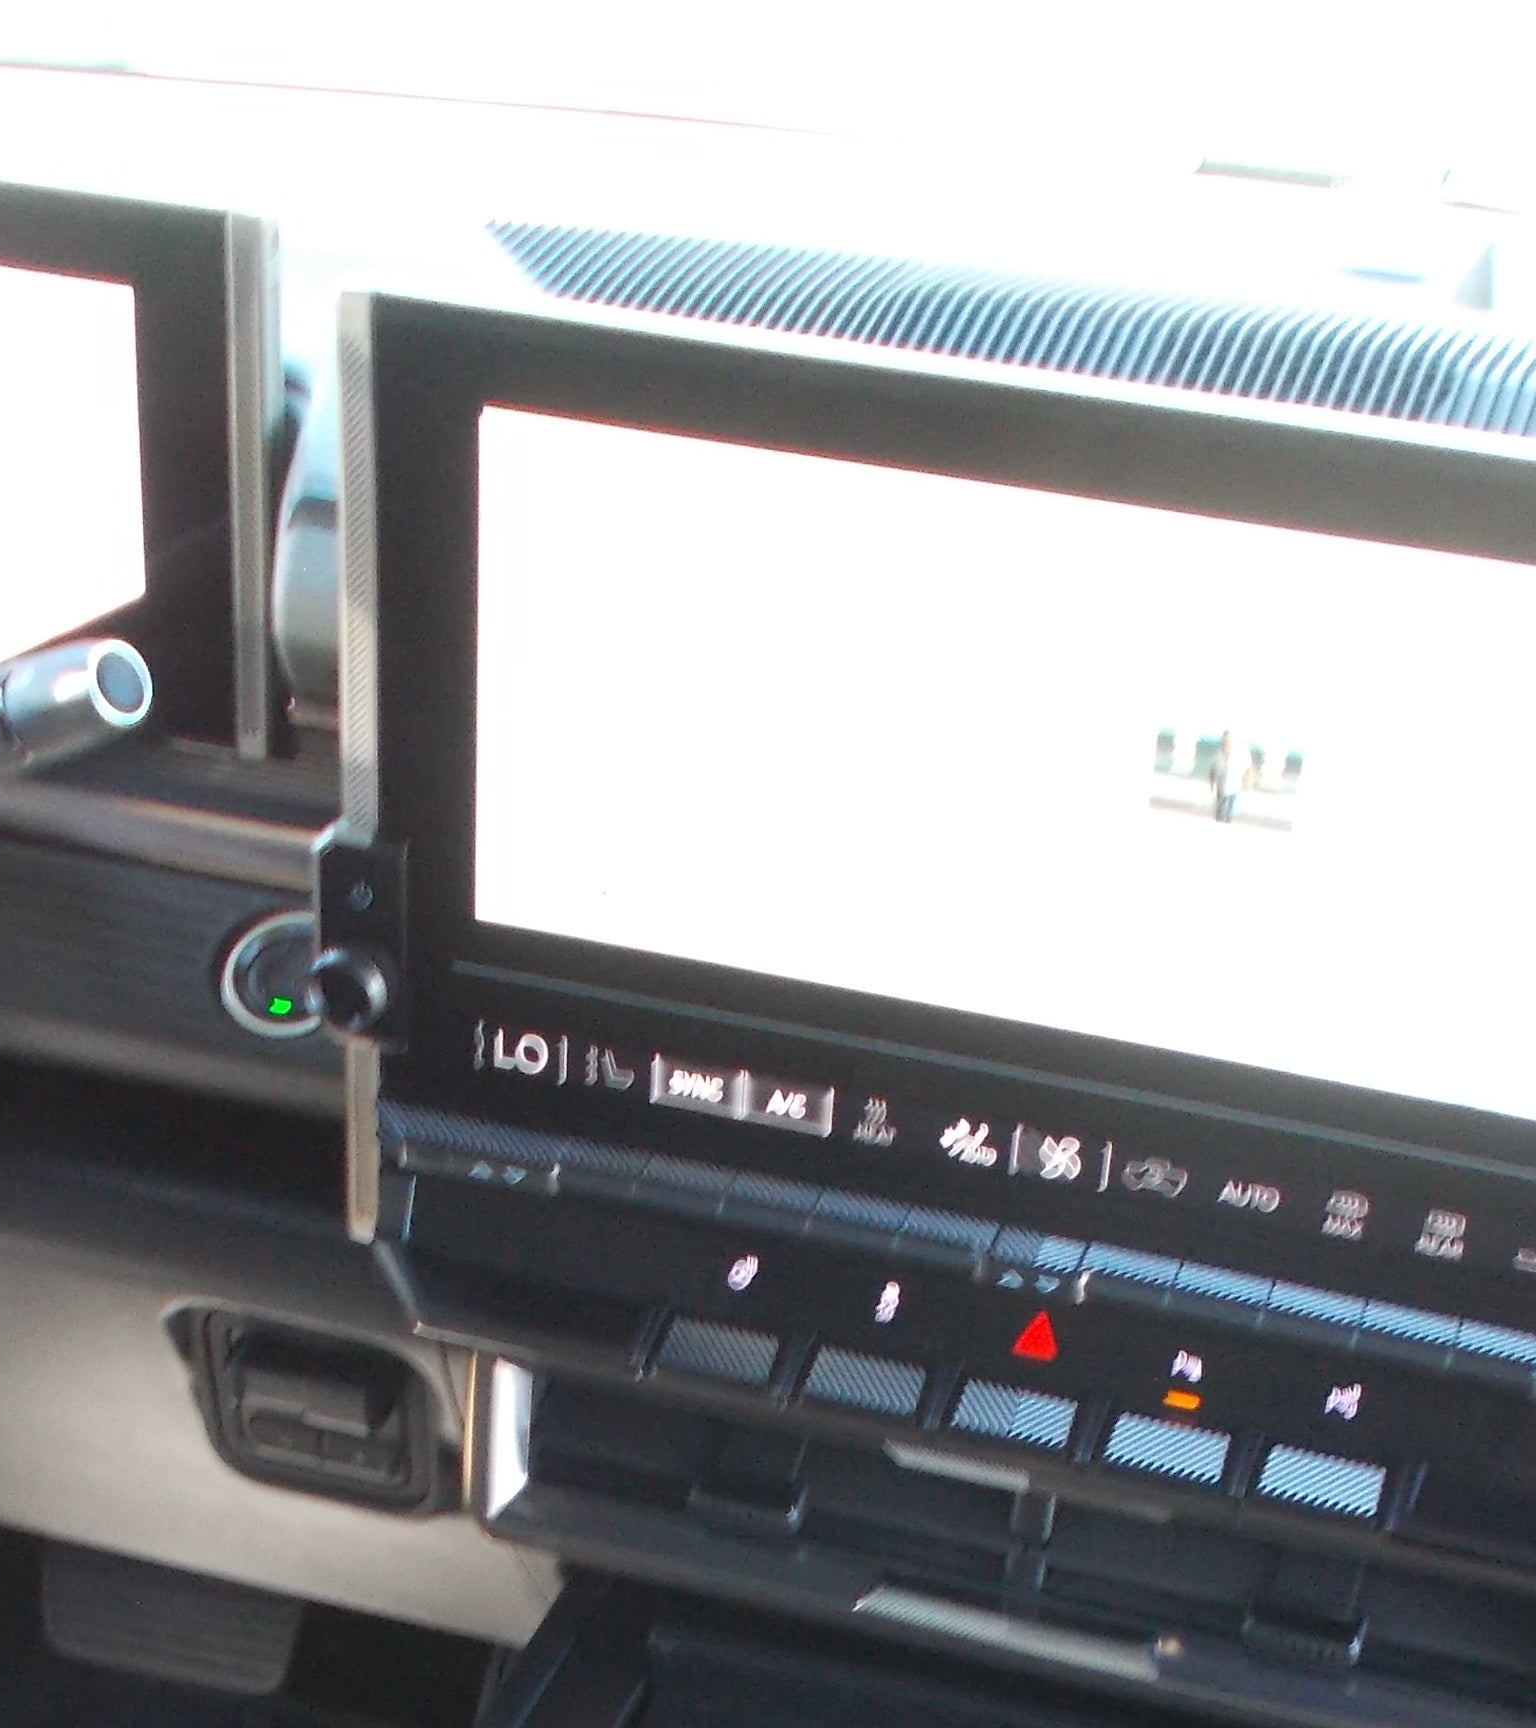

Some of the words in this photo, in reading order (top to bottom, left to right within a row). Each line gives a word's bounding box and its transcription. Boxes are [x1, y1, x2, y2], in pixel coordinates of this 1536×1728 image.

[494, 1027, 549, 1075] LO
[668, 1069, 724, 1103] SYNC
[1217, 1179, 1281, 1214] AUTO
